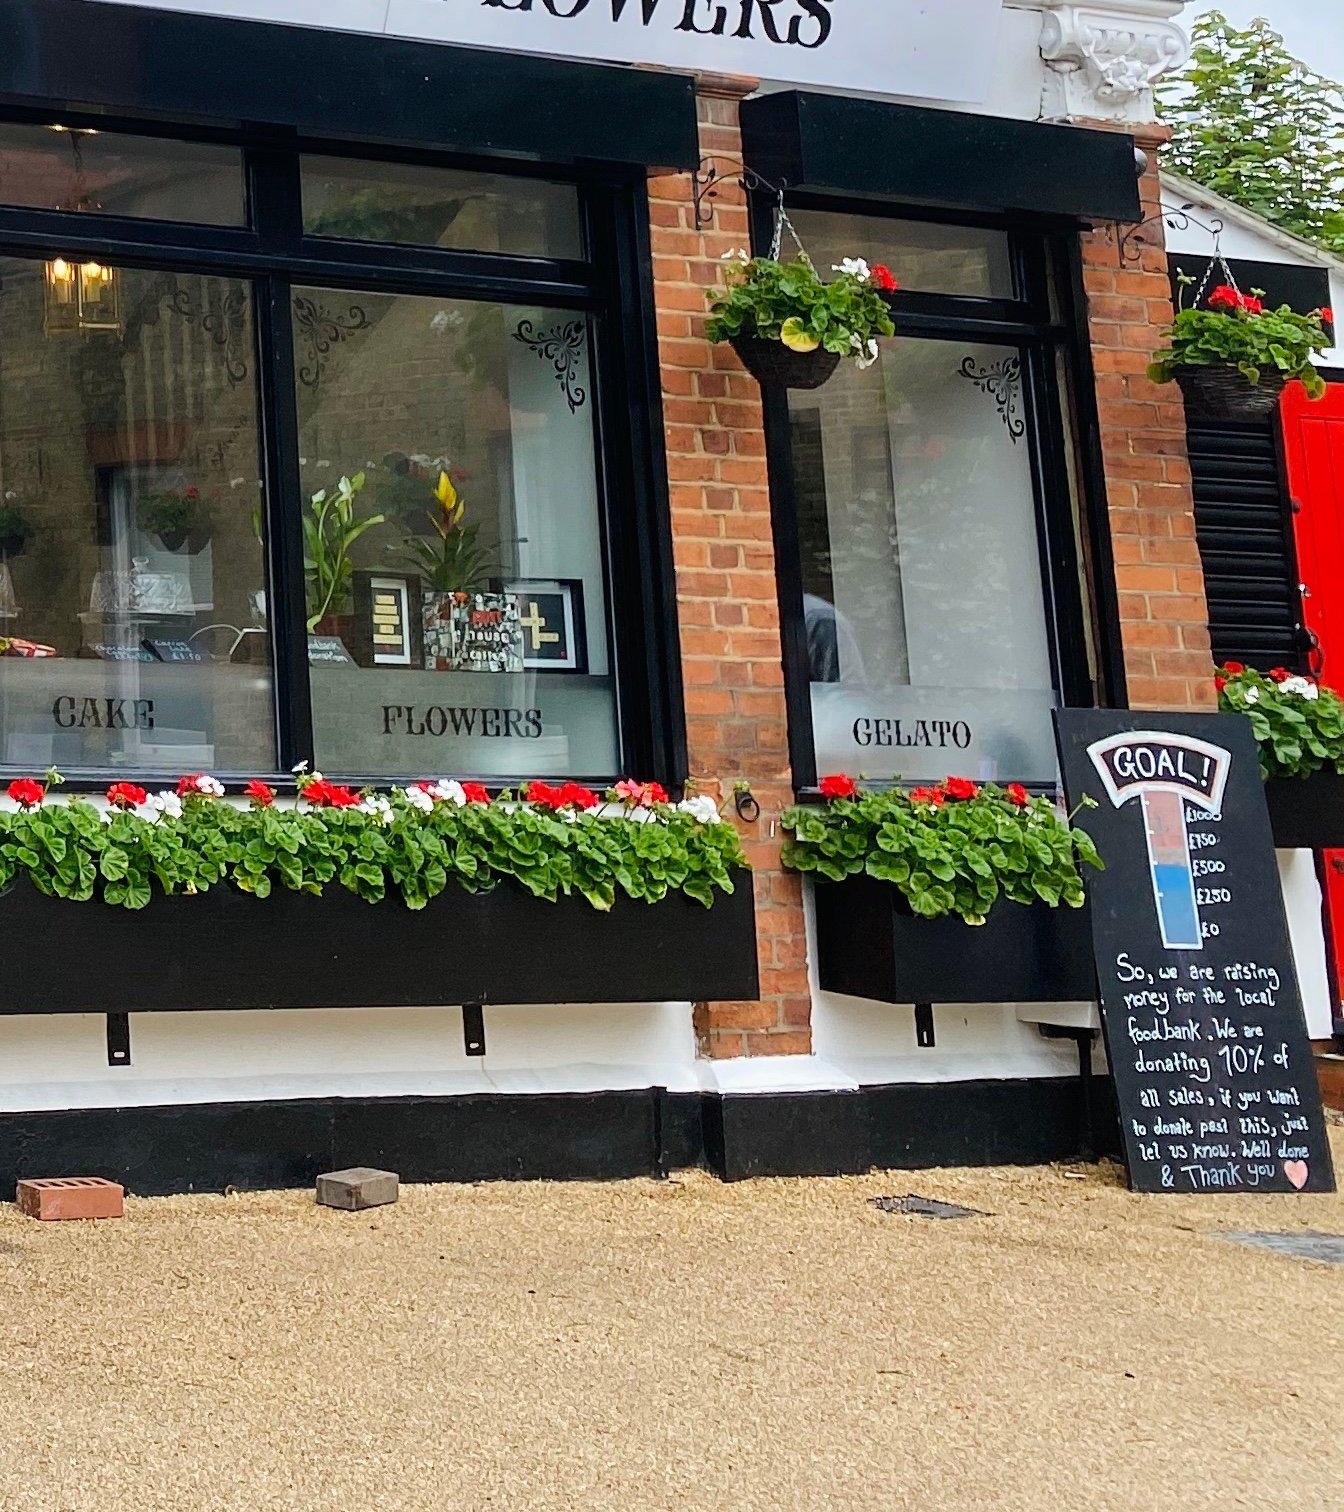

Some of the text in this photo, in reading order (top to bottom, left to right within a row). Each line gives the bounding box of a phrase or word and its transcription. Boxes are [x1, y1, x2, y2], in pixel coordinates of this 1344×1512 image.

[52, 696, 155, 730] CAKE
[381, 705, 543, 739] FLOWERS
[852, 717, 972, 749] GELATO
[1114, 746, 1211, 787] GOAL!
[1193, 860, 1226, 878] £500
[1197, 888, 1231, 905] £250
[1201, 921, 1220, 938] £0
[1159, 966, 1178, 980] we
[1190, 965, 1215, 981] are
[1224, 963, 1280, 990] raising
[1124, 987, 1275, 1015] money for the local
[1212, 1018, 1237, 1039] We
[1244, 1027, 1264, 1038] are
[1135, 1049, 1211, 1082] donating
[1273, 1042, 1289, 1070] of
[1140, 1088, 1161, 1107] all
[1219, 1088, 1232, 1108] if
[1237, 1091, 1261, 1111] you
[1132, 1118, 1147, 1136] to
[1153, 1117, 1193, 1137] donate
[1200, 1118, 1228, 1138] past
[1281, 1112, 1309, 1136] just
[1139, 1141, 1161, 1161] let
[1168, 1143, 1188, 1159] us
[1240, 1140, 1271, 1159] Well
[1277, 1140, 1309, 1159] done
[1162, 1162, 1275, 1188] & Thank you
